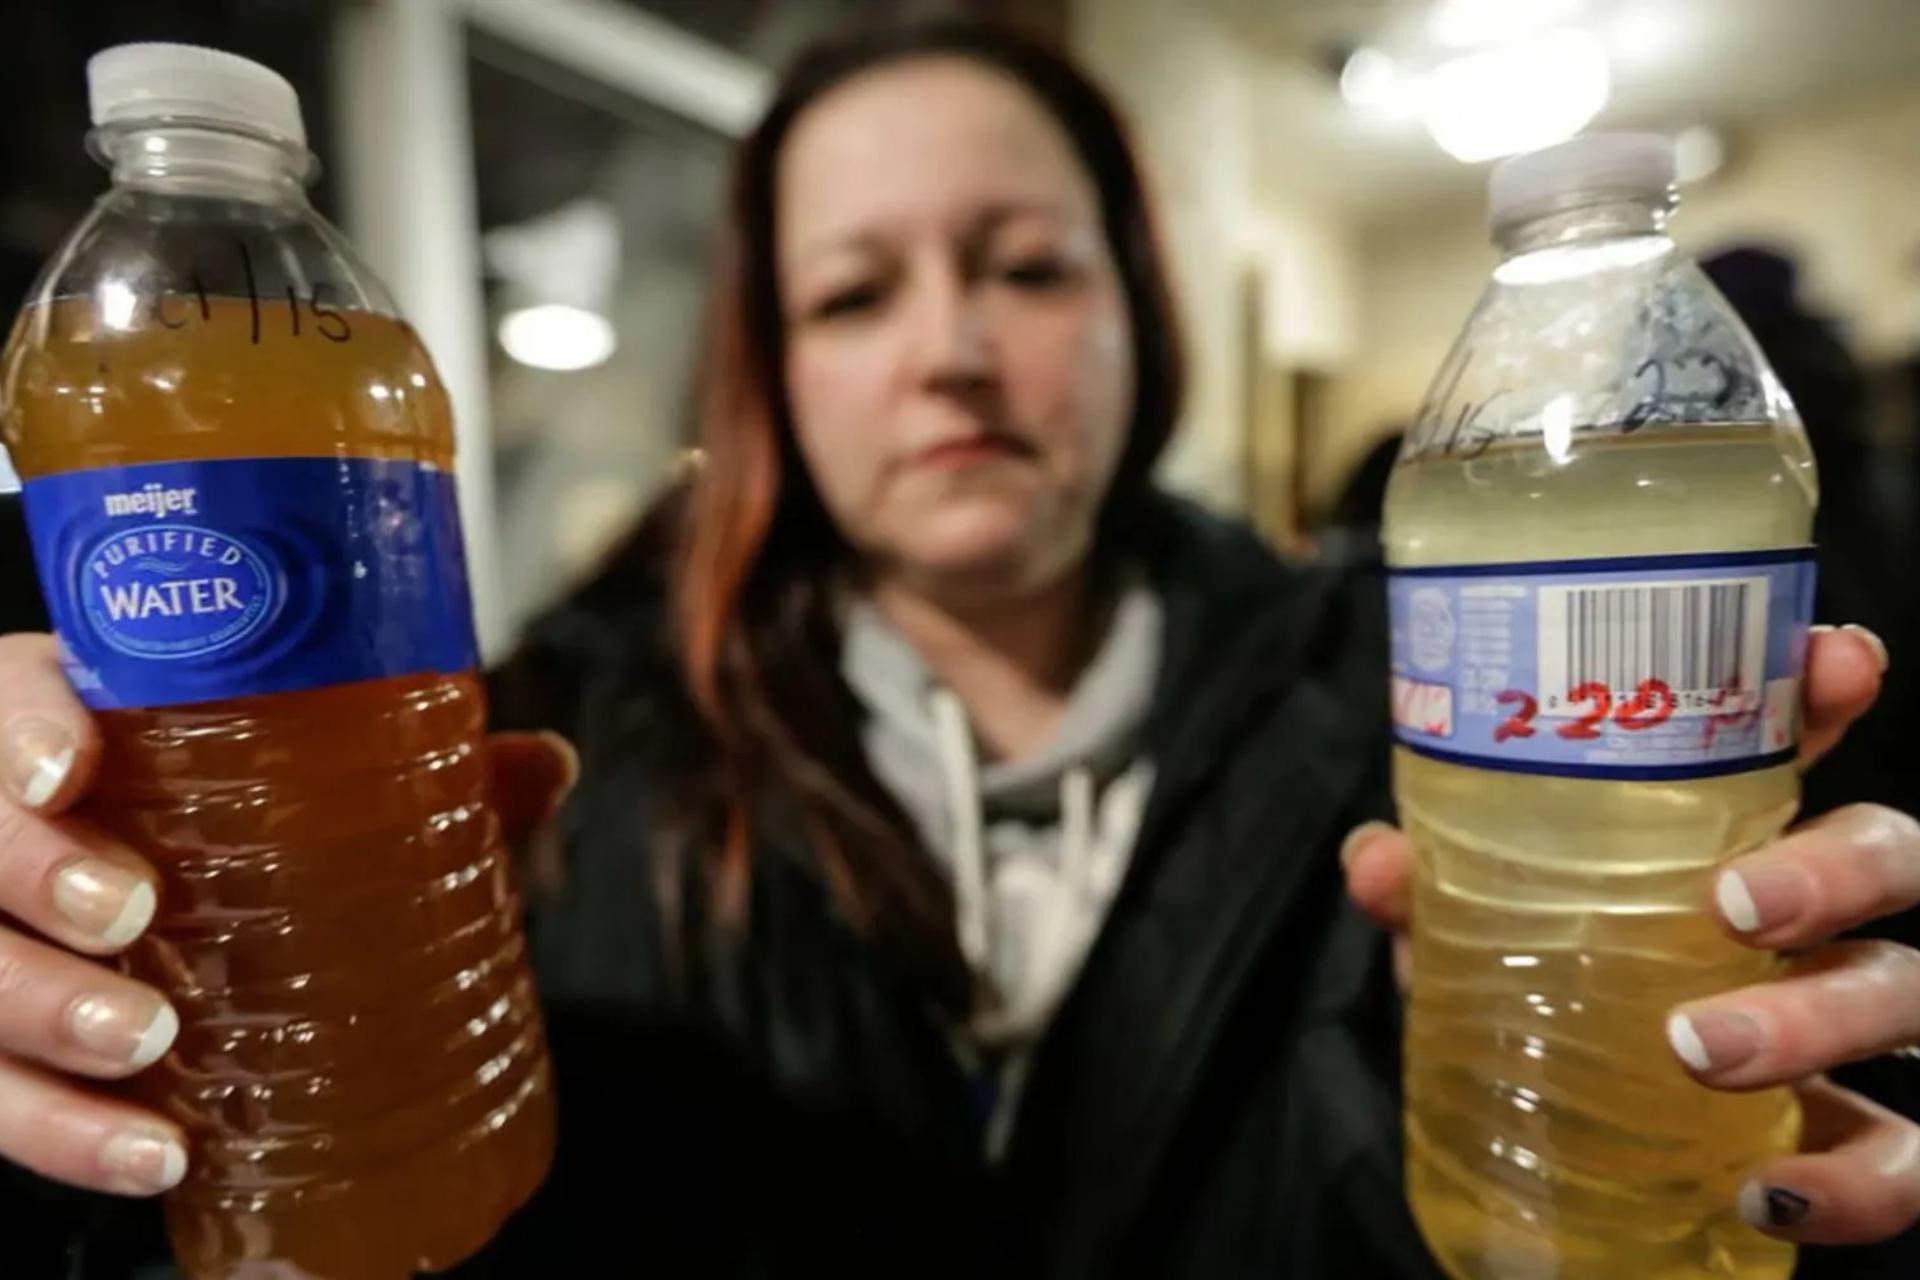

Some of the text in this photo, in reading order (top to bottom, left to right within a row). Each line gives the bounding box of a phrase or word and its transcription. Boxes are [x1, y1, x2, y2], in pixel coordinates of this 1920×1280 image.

[103, 482, 198, 518] meijer
[92, 531, 243, 579] PURIFIED
[100, 576, 245, 621] WATER
